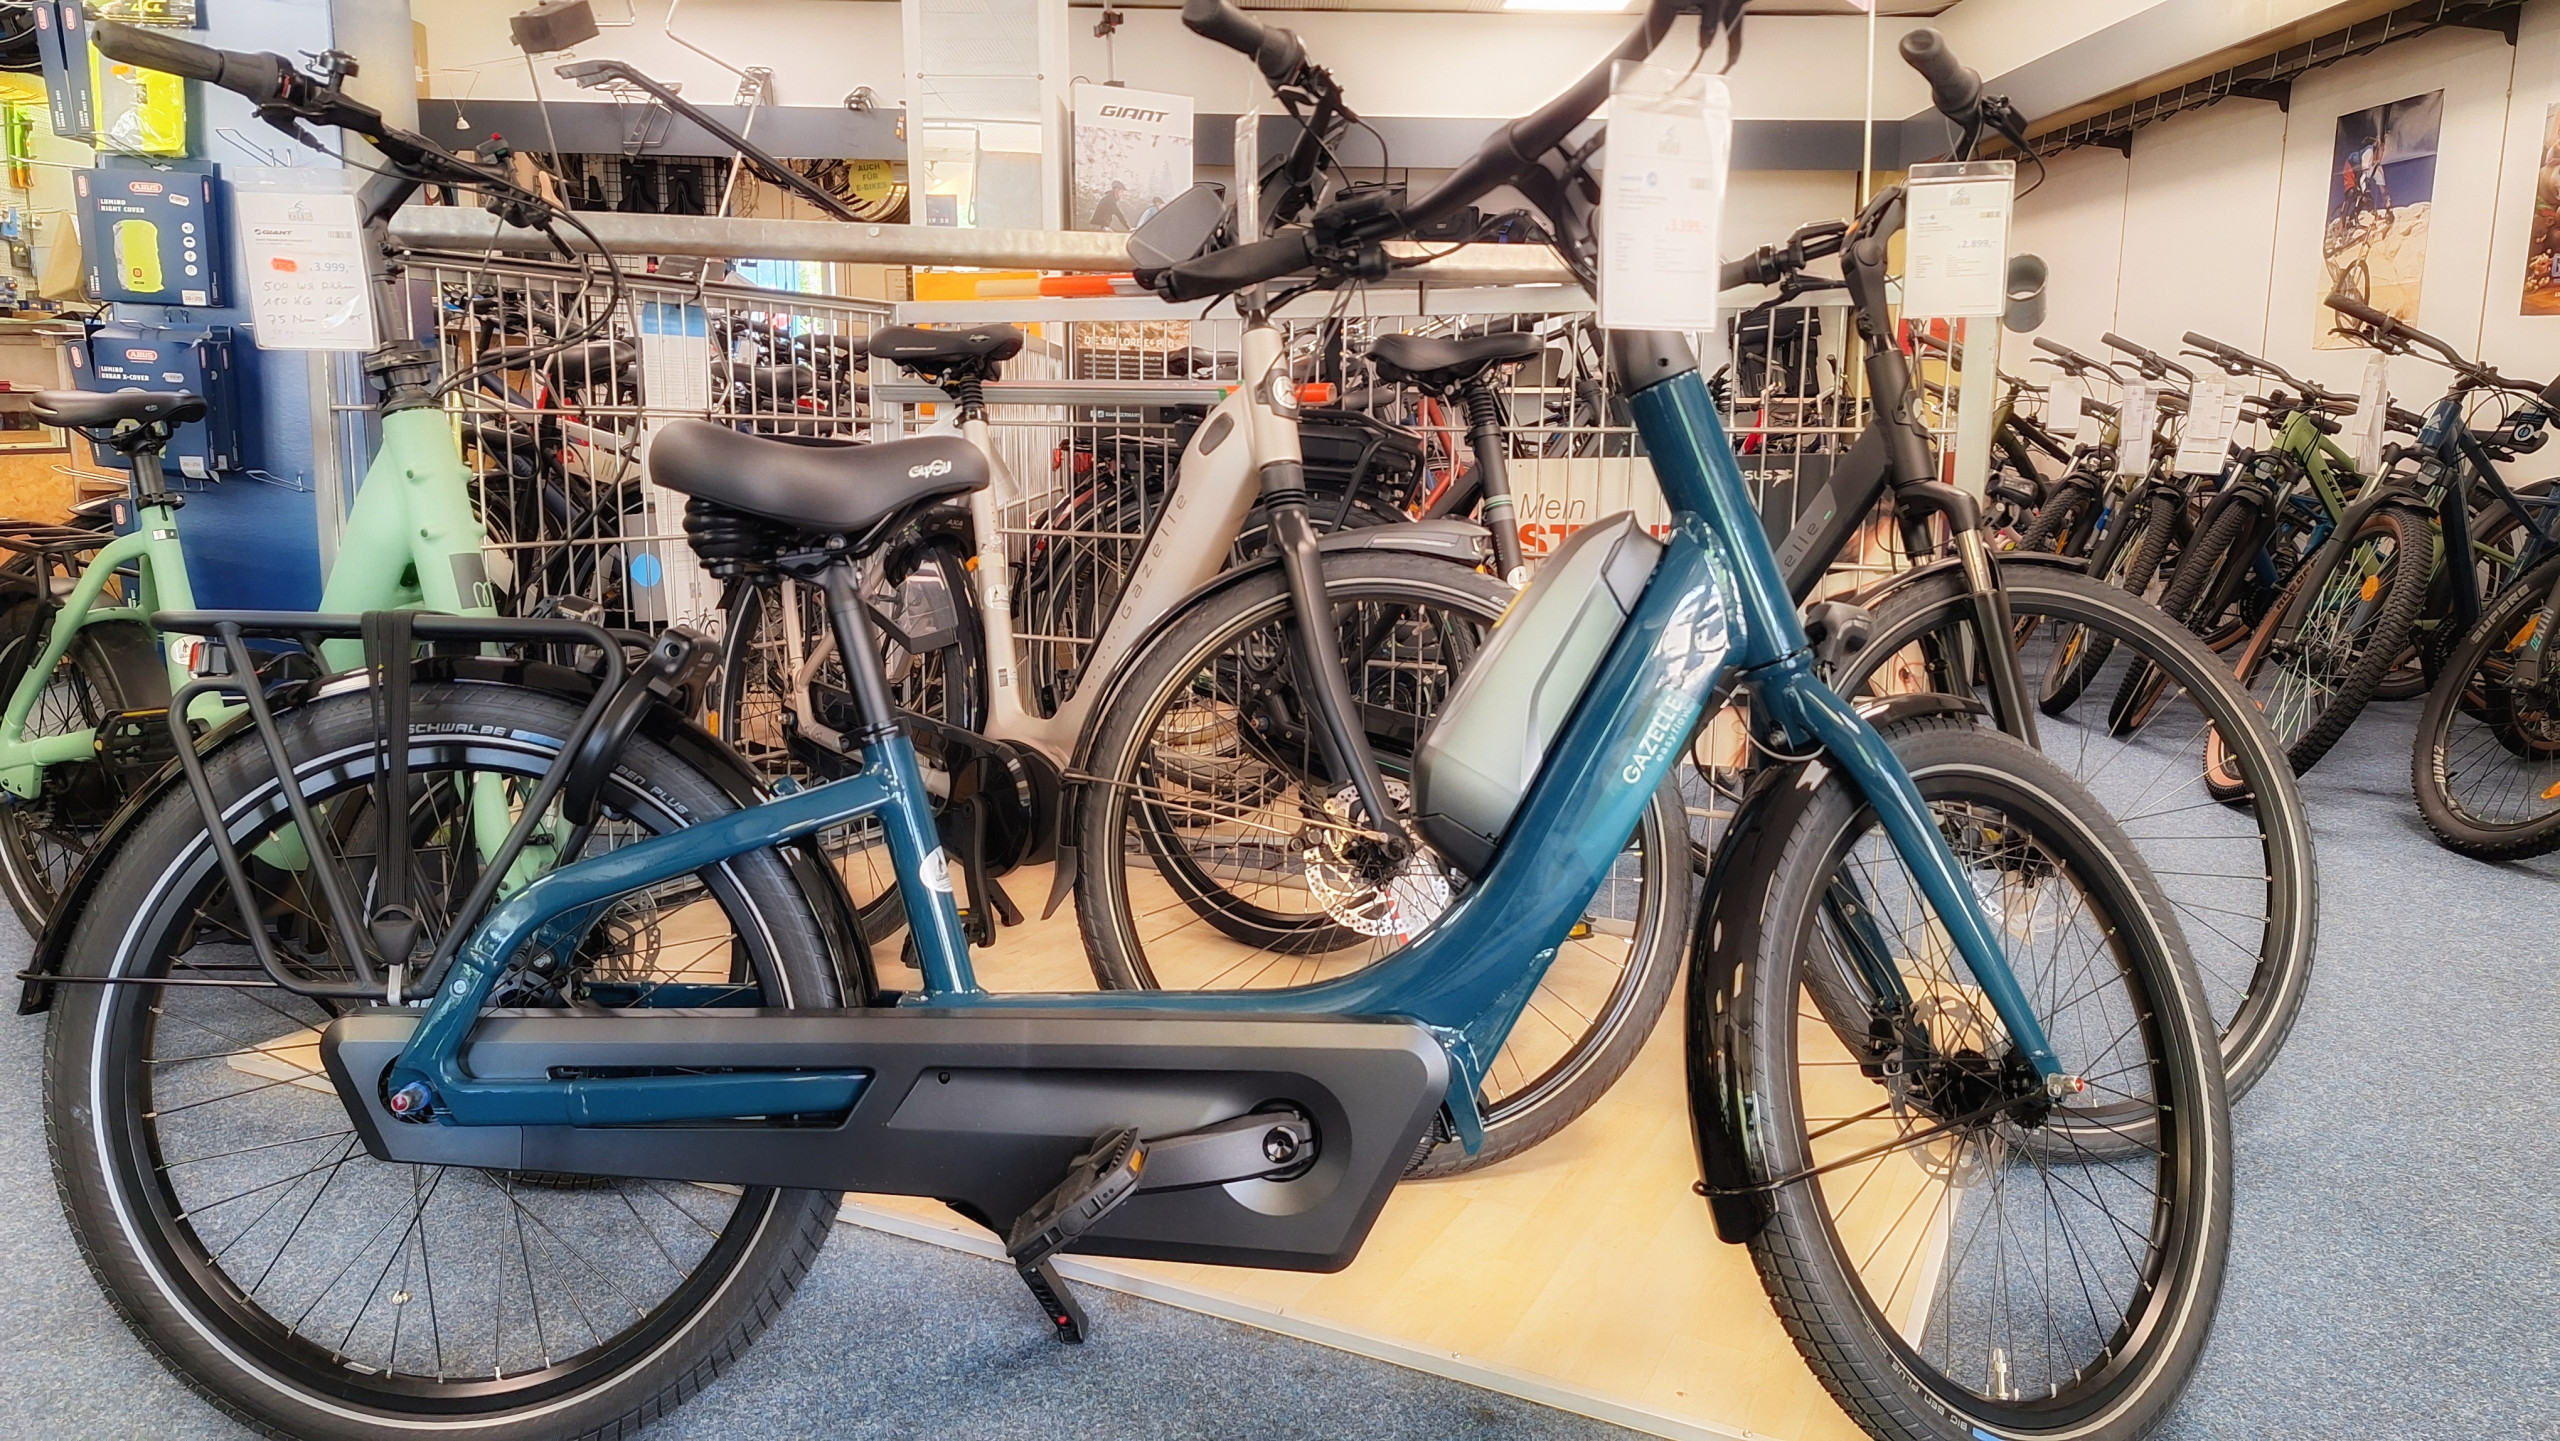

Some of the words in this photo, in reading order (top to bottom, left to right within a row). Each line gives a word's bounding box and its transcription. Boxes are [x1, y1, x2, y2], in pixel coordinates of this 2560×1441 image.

[1099, 104, 1172, 123] GIANT
[858, 162, 881, 172] AUCH
[862, 172, 879, 181] FÜR
[856, 181, 888, 191] E-BIKES
[263, 281, 288, 291] 500
[294, 295, 312, 306] KG
[1084, 336, 1101, 345] DE
[1519, 493, 1586, 520] Mein
[946, 518, 964, 527] AXA
[1121, 494, 1187, 620] Gazelle
[1783, 523, 1819, 577] elle
[408, 723, 507, 736] SCHWALBE
[1656, 705, 1692, 763] easyflow
[1622, 695, 1684, 784] GAZELLE
[616, 764, 646, 785] BEN
[650, 786, 689, 814] PLUS
[1891, 1360, 1920, 1393] PLUS
[1923, 1393, 1945, 1416] BEN
[1949, 1415, 1968, 1431] BIG
